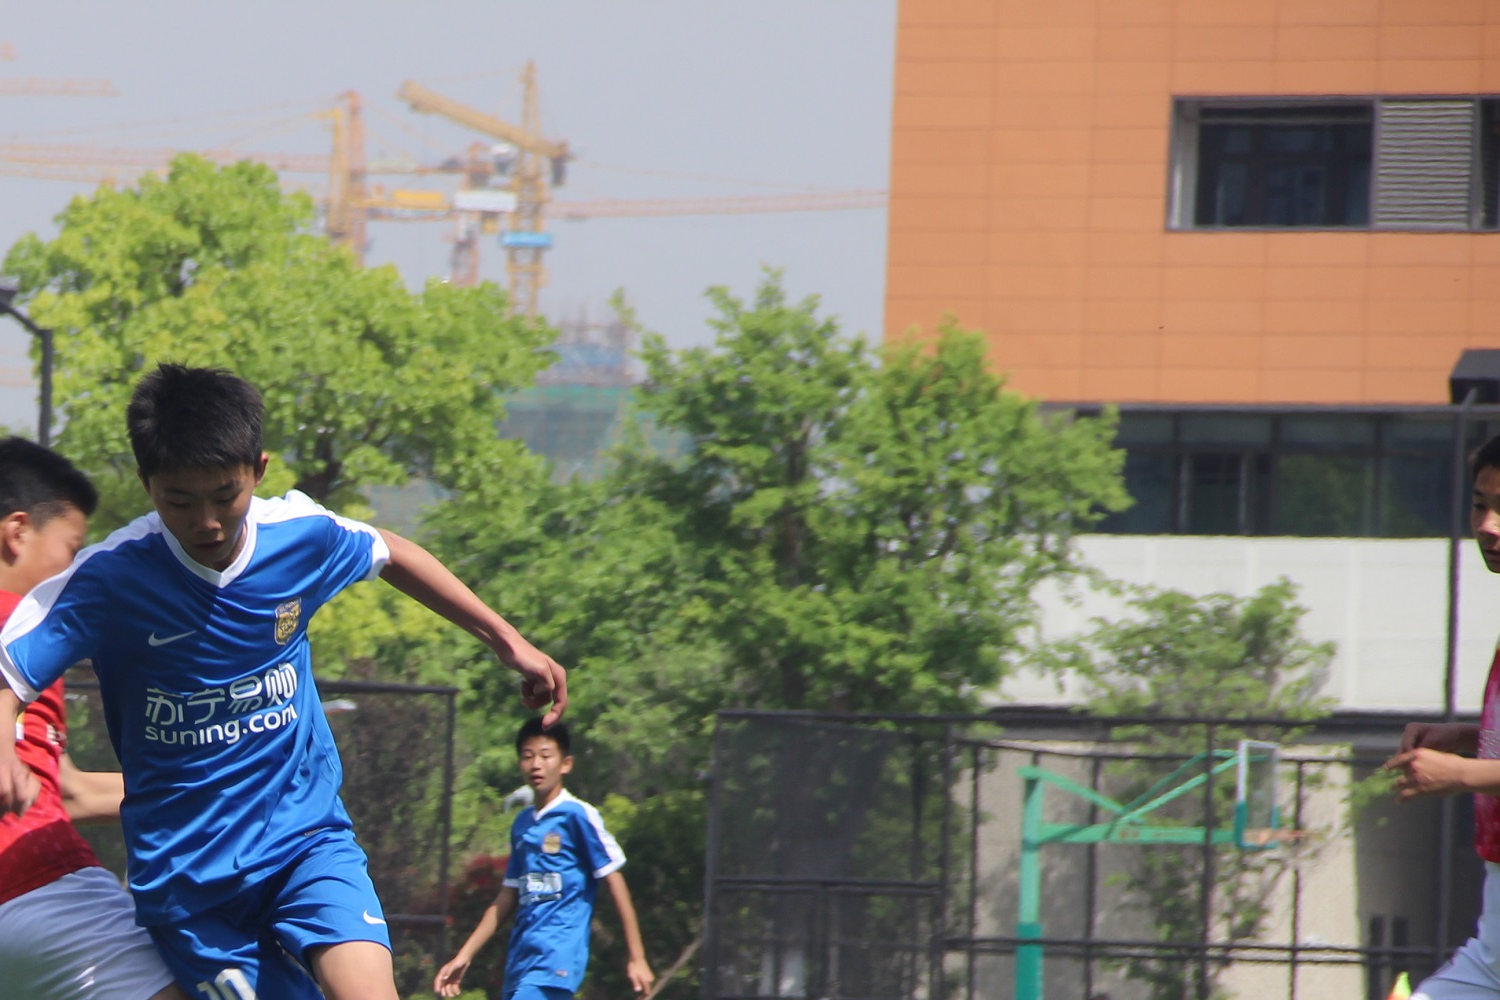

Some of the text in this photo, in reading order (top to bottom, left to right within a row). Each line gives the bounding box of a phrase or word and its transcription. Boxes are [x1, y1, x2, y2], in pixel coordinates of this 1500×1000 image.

[145, 662, 298, 726] 苏宁易购
[145, 703, 298, 746] suning.com
